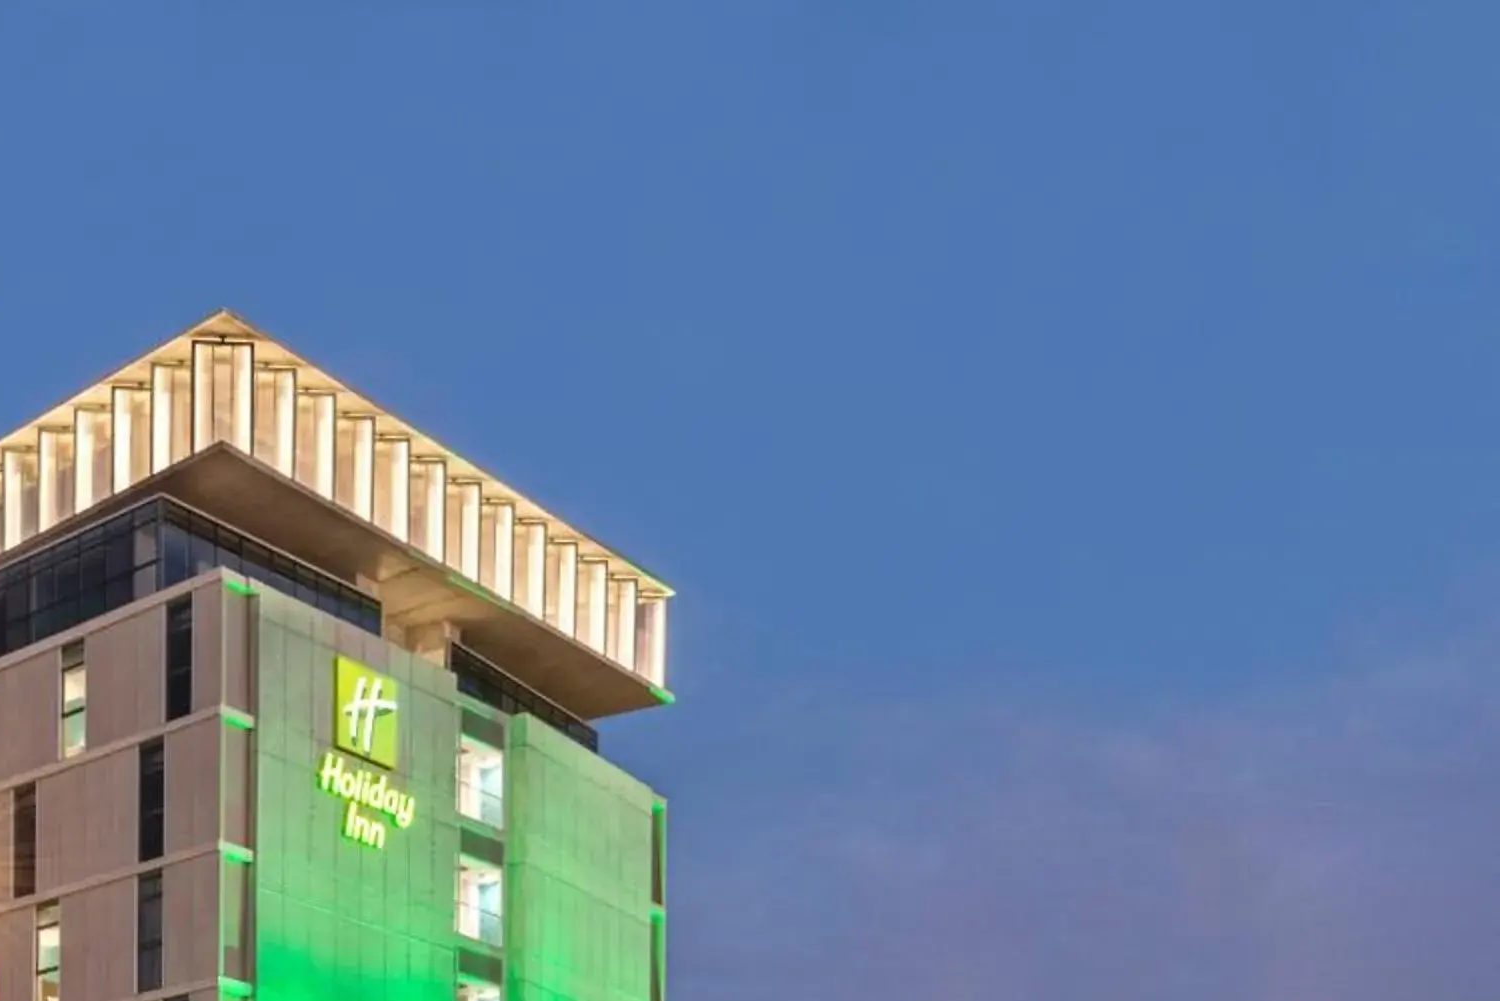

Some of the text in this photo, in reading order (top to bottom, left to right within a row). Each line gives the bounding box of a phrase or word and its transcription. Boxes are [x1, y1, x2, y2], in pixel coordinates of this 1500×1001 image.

[342, 676, 398, 752] H
[319, 752, 416, 829] Holiday
[344, 800, 386, 849] Inn
